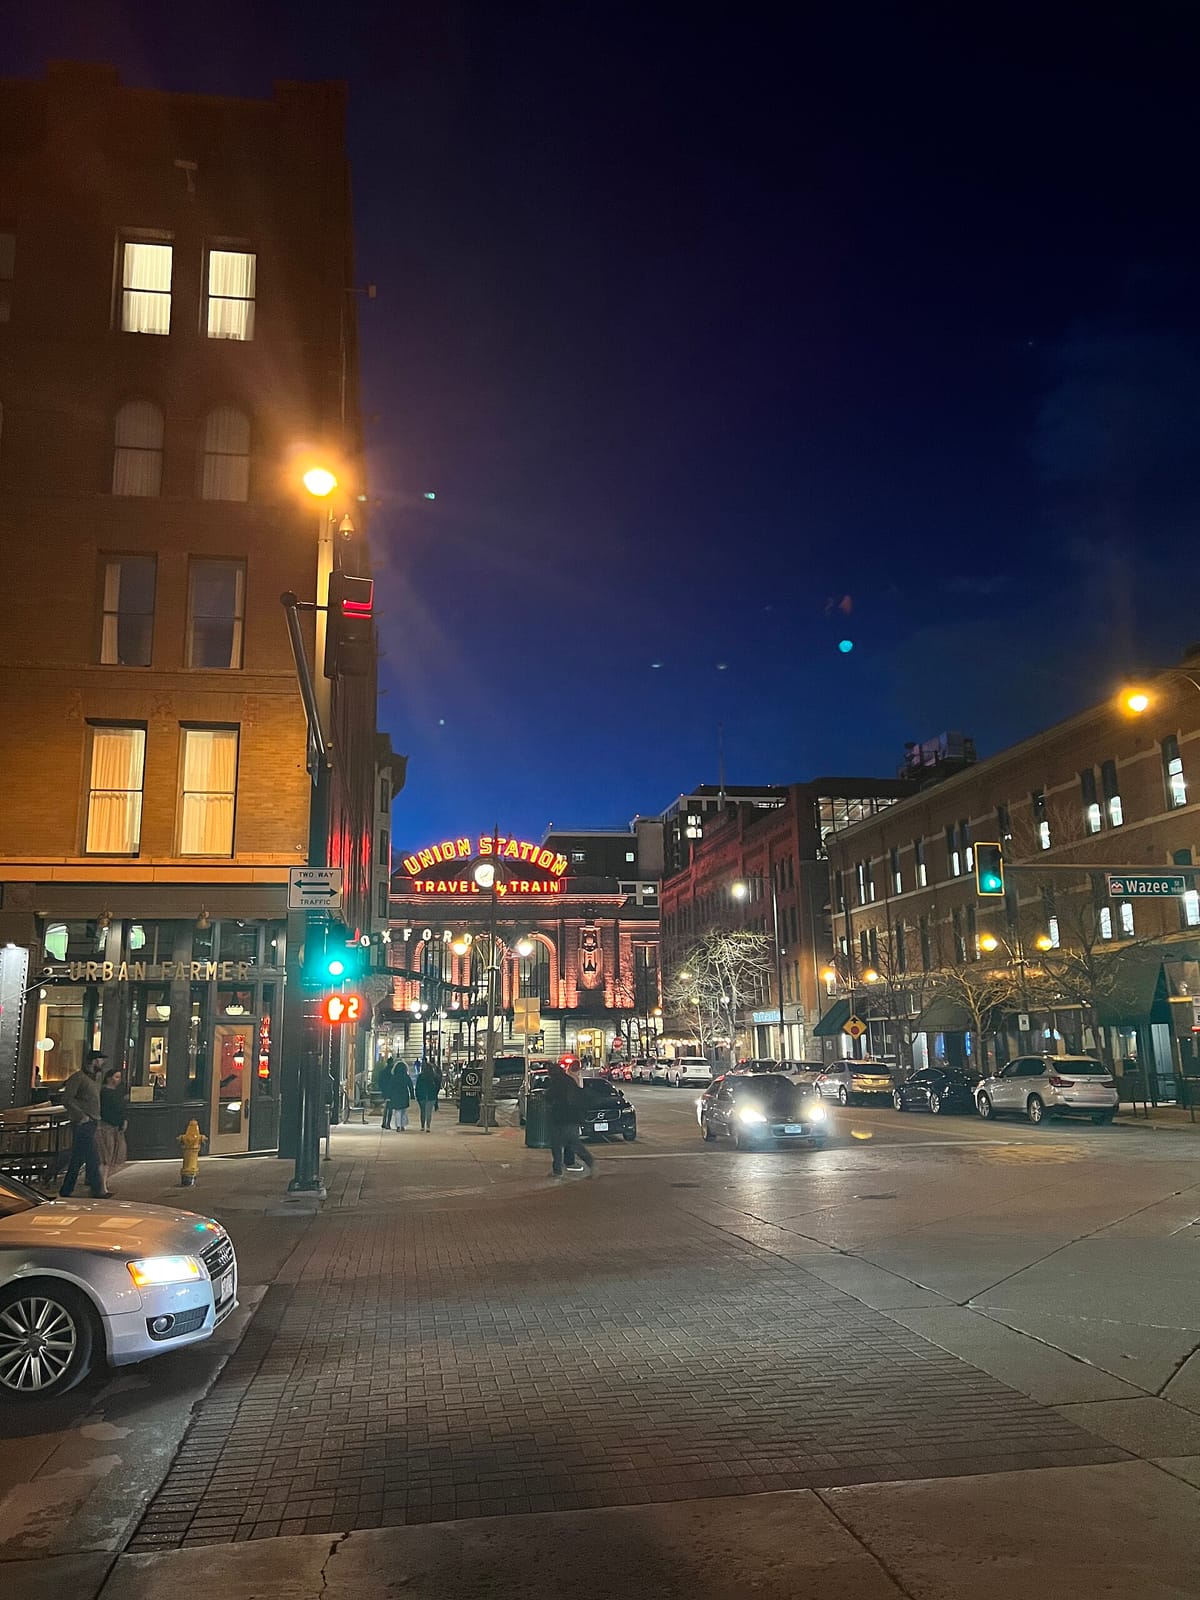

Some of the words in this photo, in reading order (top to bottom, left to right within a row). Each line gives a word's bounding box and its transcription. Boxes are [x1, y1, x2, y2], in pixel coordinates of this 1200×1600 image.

[403, 838, 472, 876] UNION
[479, 837, 568, 877] STATION
[414, 881, 480, 893] TRAVEL
[510, 881, 560, 893] TRAIN
[1126, 880, 1169, 893] Wazee
[360, 928, 473, 947] OXFORD
[69, 961, 146, 981] URBAN
[160, 961, 250, 981] FARMER
[348, 997, 359, 1018] 2
